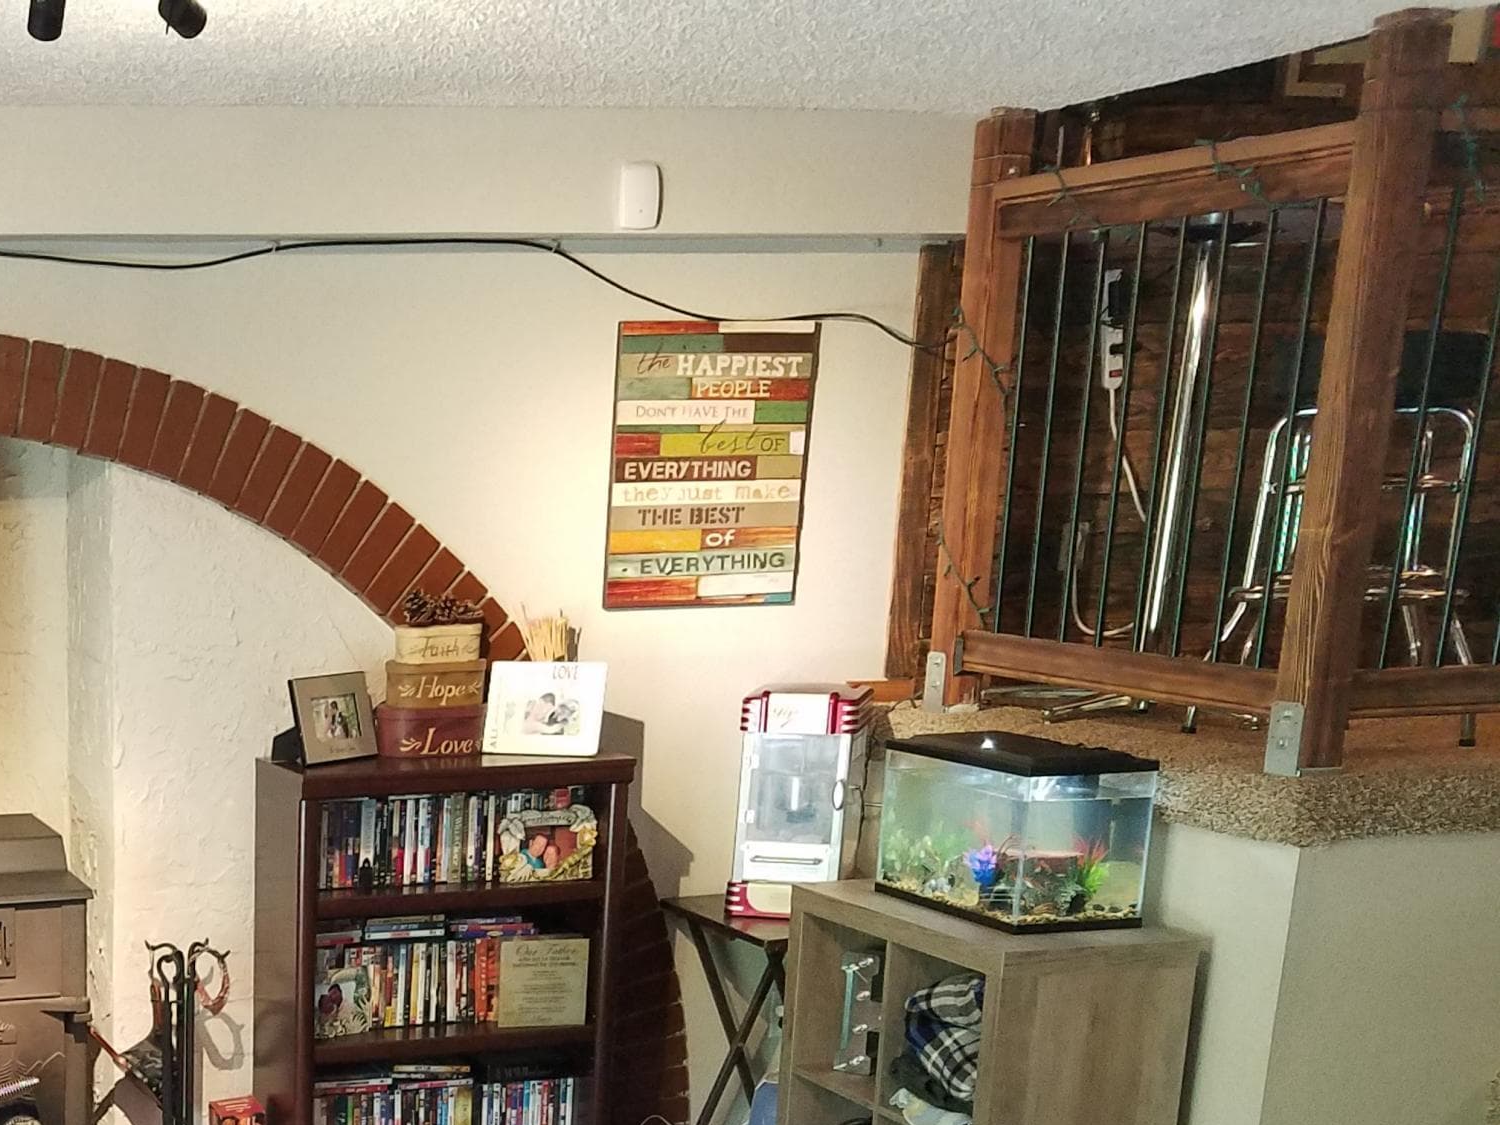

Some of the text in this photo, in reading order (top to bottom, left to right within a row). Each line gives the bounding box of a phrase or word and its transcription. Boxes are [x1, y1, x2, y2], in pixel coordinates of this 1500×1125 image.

[637, 344, 804, 377] the HAPPIEST
[695, 379, 772, 398] PEOPLE
[681, 404, 720, 419] HAVE
[724, 405, 749, 422] THE
[700, 419, 786, 454] best OF
[624, 460, 752, 481] EVERYTHING
[622, 484, 791, 503] they just make
[637, 506, 746, 526] THE BEST
[705, 529, 736, 548] of
[640, 552, 786, 576] EVERYTHING
[421, 636, 459, 658] Faith
[552, 664, 580, 681] LOVE
[416, 675, 467, 706] Hope
[421, 727, 473, 756] Love
